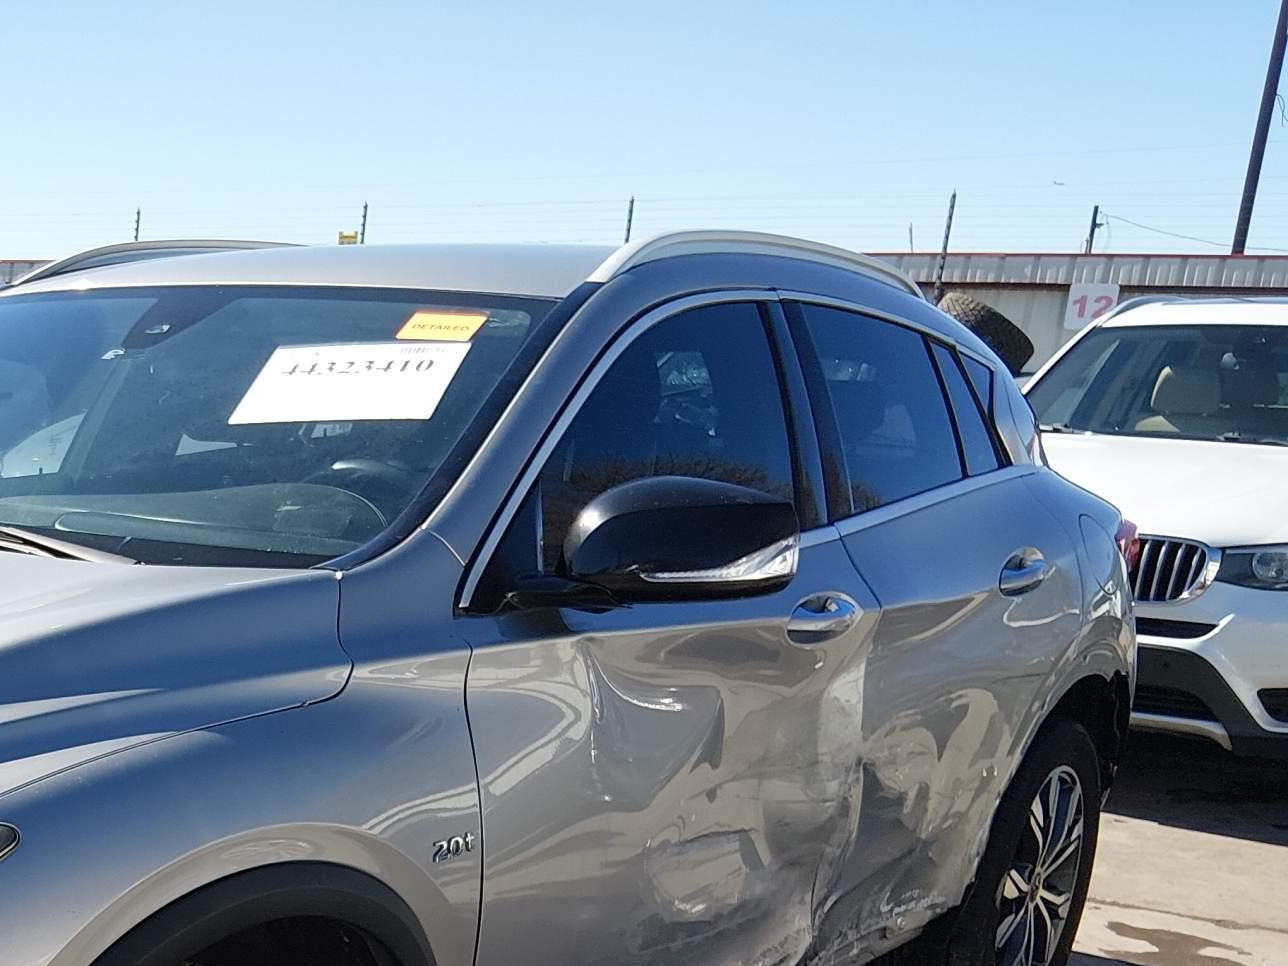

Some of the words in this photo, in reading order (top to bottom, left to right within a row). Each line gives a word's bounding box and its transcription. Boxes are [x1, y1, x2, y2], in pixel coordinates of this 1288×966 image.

[1073, 295, 1114, 319] 12
[412, 323, 471, 333] DETAILED
[280, 359, 435, 376] 44323410
